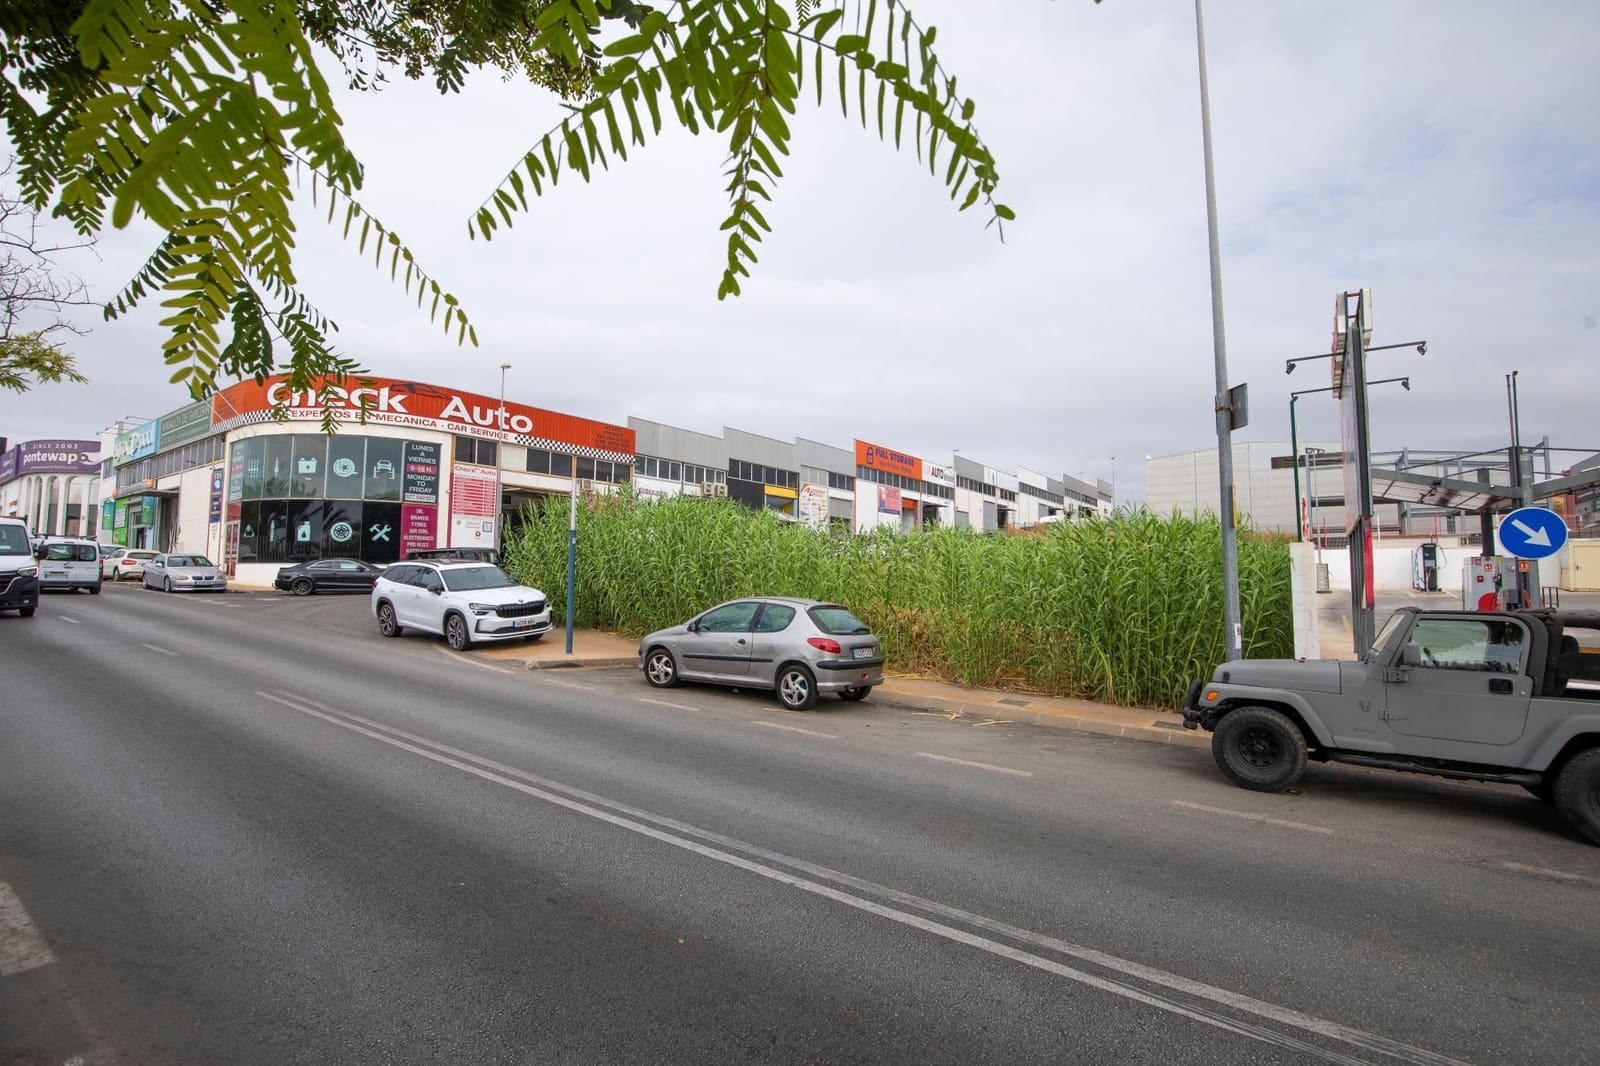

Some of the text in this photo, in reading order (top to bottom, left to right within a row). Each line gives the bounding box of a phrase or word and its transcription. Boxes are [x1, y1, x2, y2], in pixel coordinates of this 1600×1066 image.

[267, 382, 408, 413] Check
[376, 414, 437, 428] MECANICA
[447, 423, 468, 433] CAR
[440, 396, 533, 433] Auto
[23, 451, 78, 466] pontewap
[875, 448, 915, 467] FULL STORAGE
